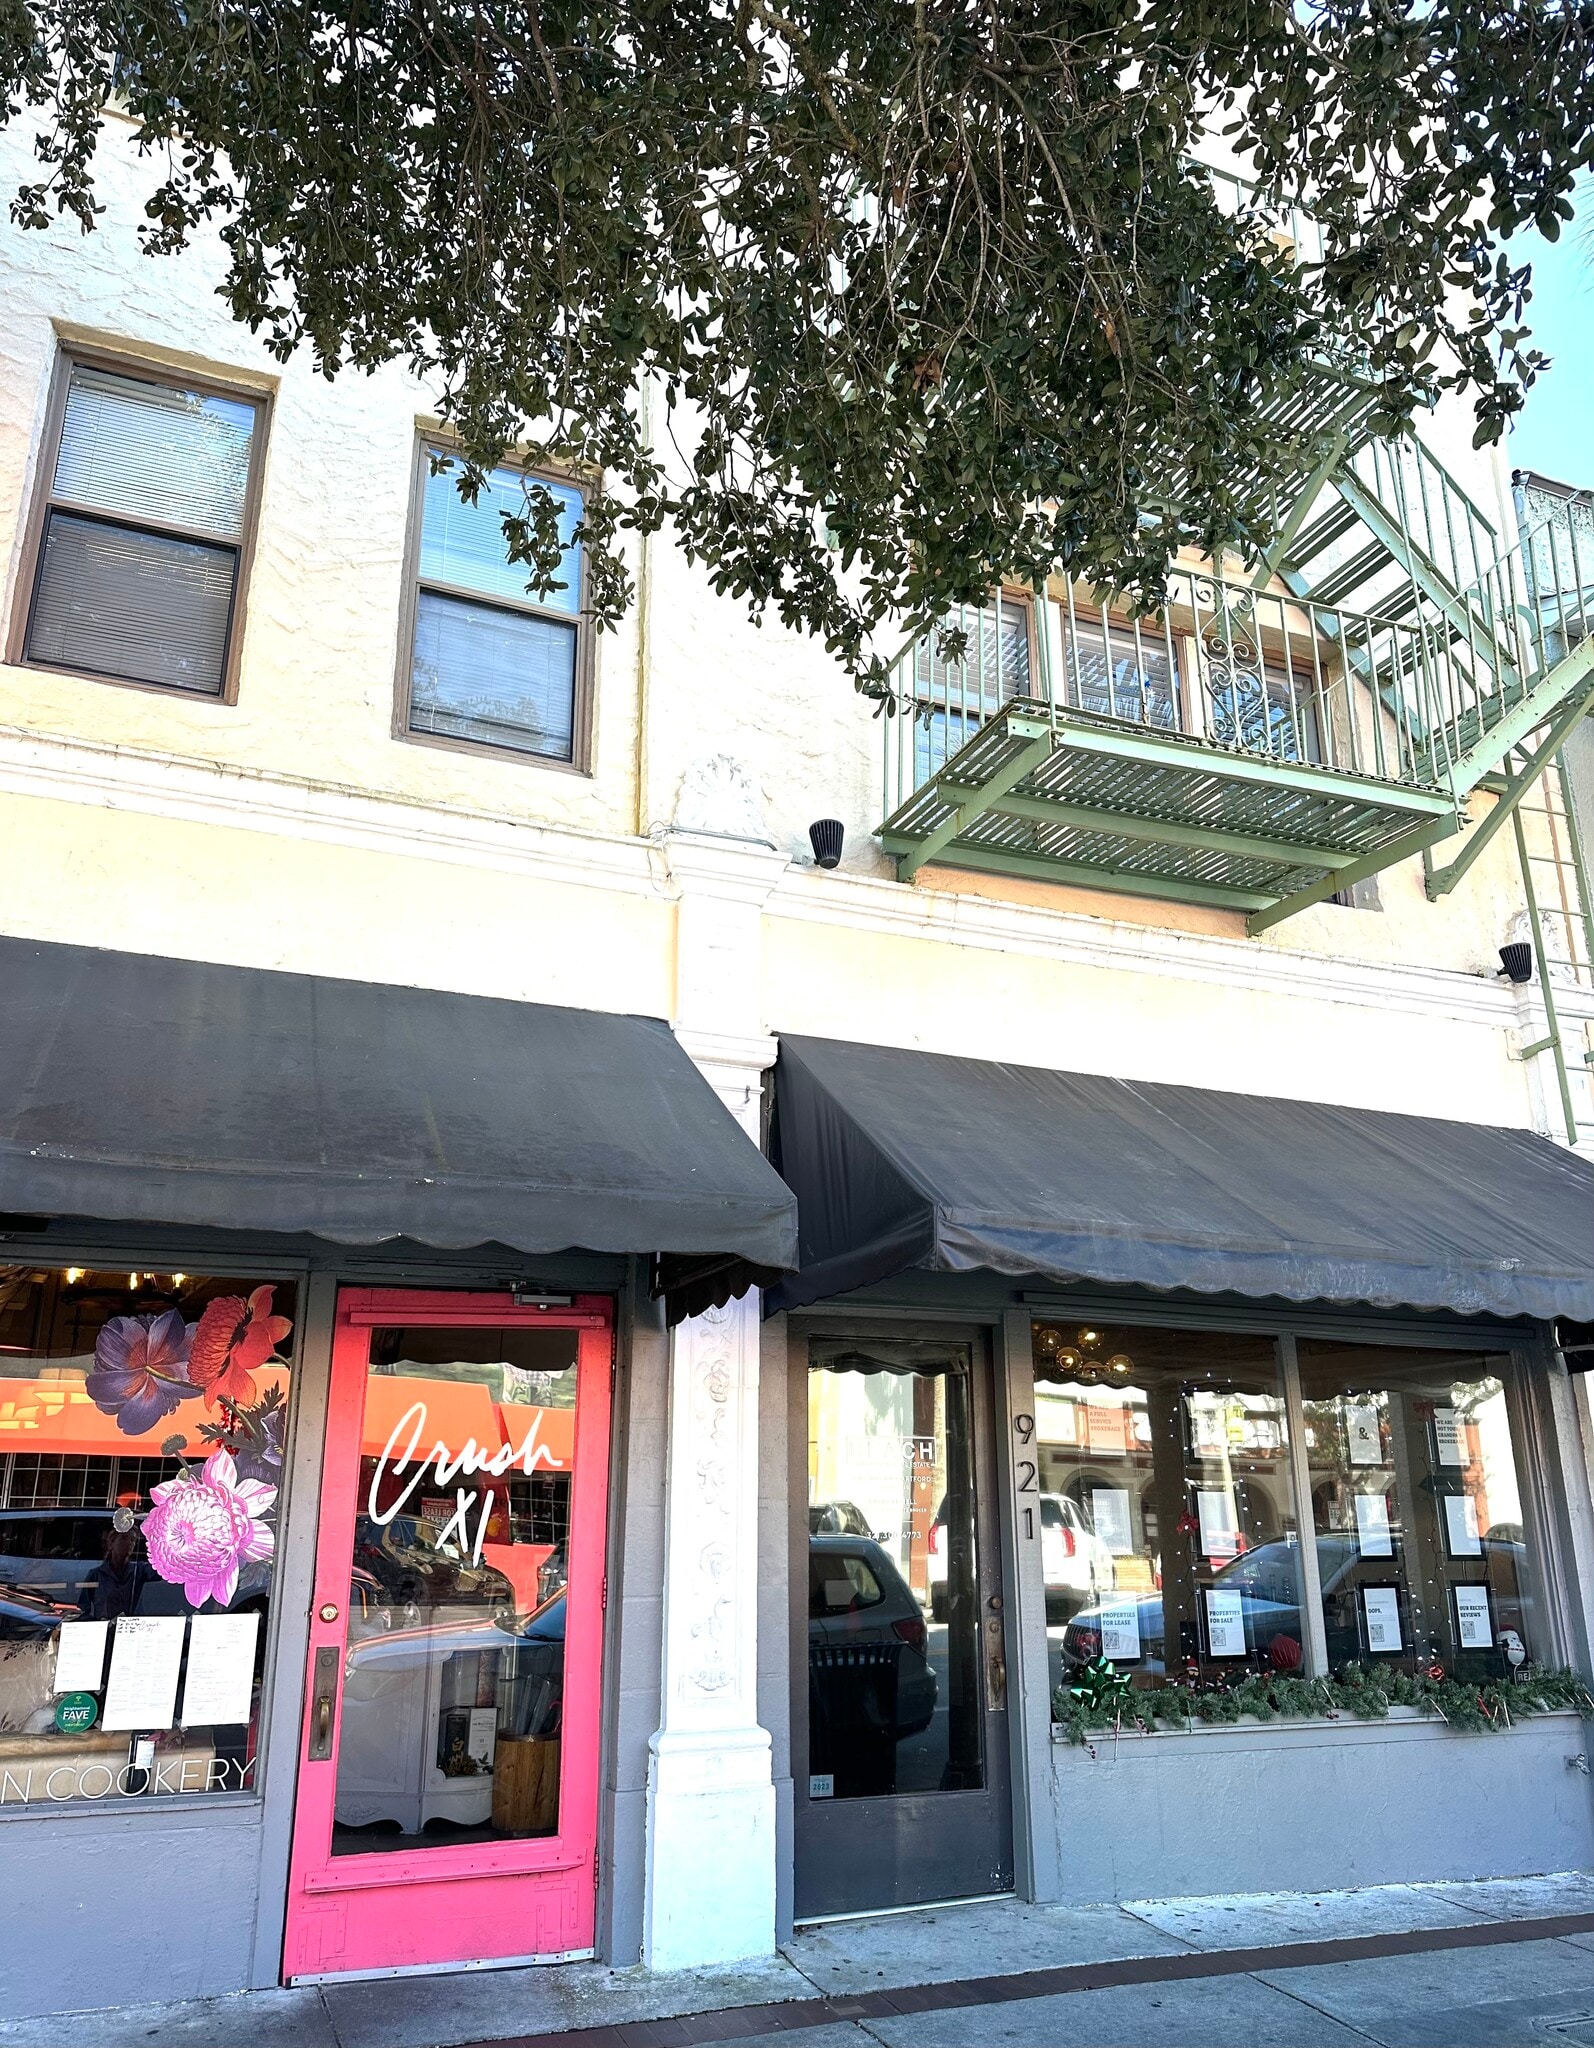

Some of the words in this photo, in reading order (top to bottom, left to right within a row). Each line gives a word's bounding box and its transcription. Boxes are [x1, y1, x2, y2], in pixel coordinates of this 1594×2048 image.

[1359, 1427, 1369, 1440] &
[368, 1402, 563, 1525] Crush
[62, 1710, 90, 1720] FAVE
[46, 1757, 257, 1801] COOKERY
